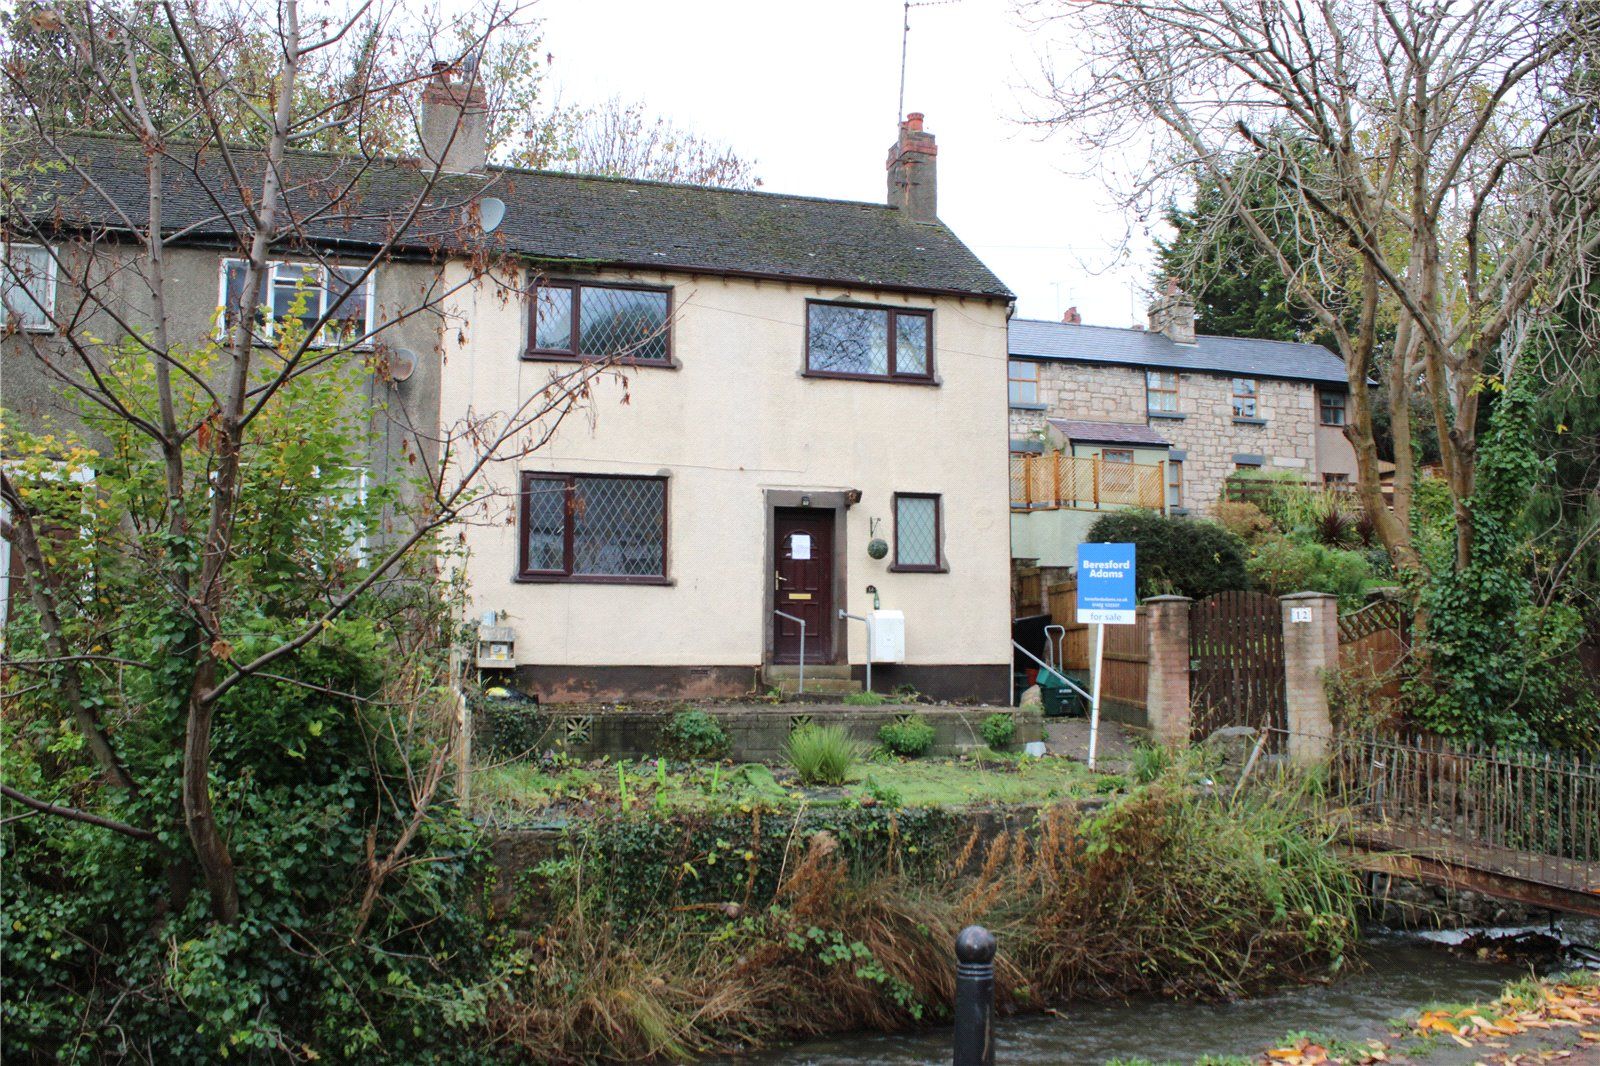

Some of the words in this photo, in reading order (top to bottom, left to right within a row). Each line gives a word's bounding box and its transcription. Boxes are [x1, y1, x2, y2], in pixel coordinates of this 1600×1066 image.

[1083, 560, 1129, 569] Beresford
[1089, 569, 1124, 578] Adams
[1091, 613, 1102, 621] for
[1105, 613, 1121, 621] sale
[1296, 610, 1308, 620] 12
